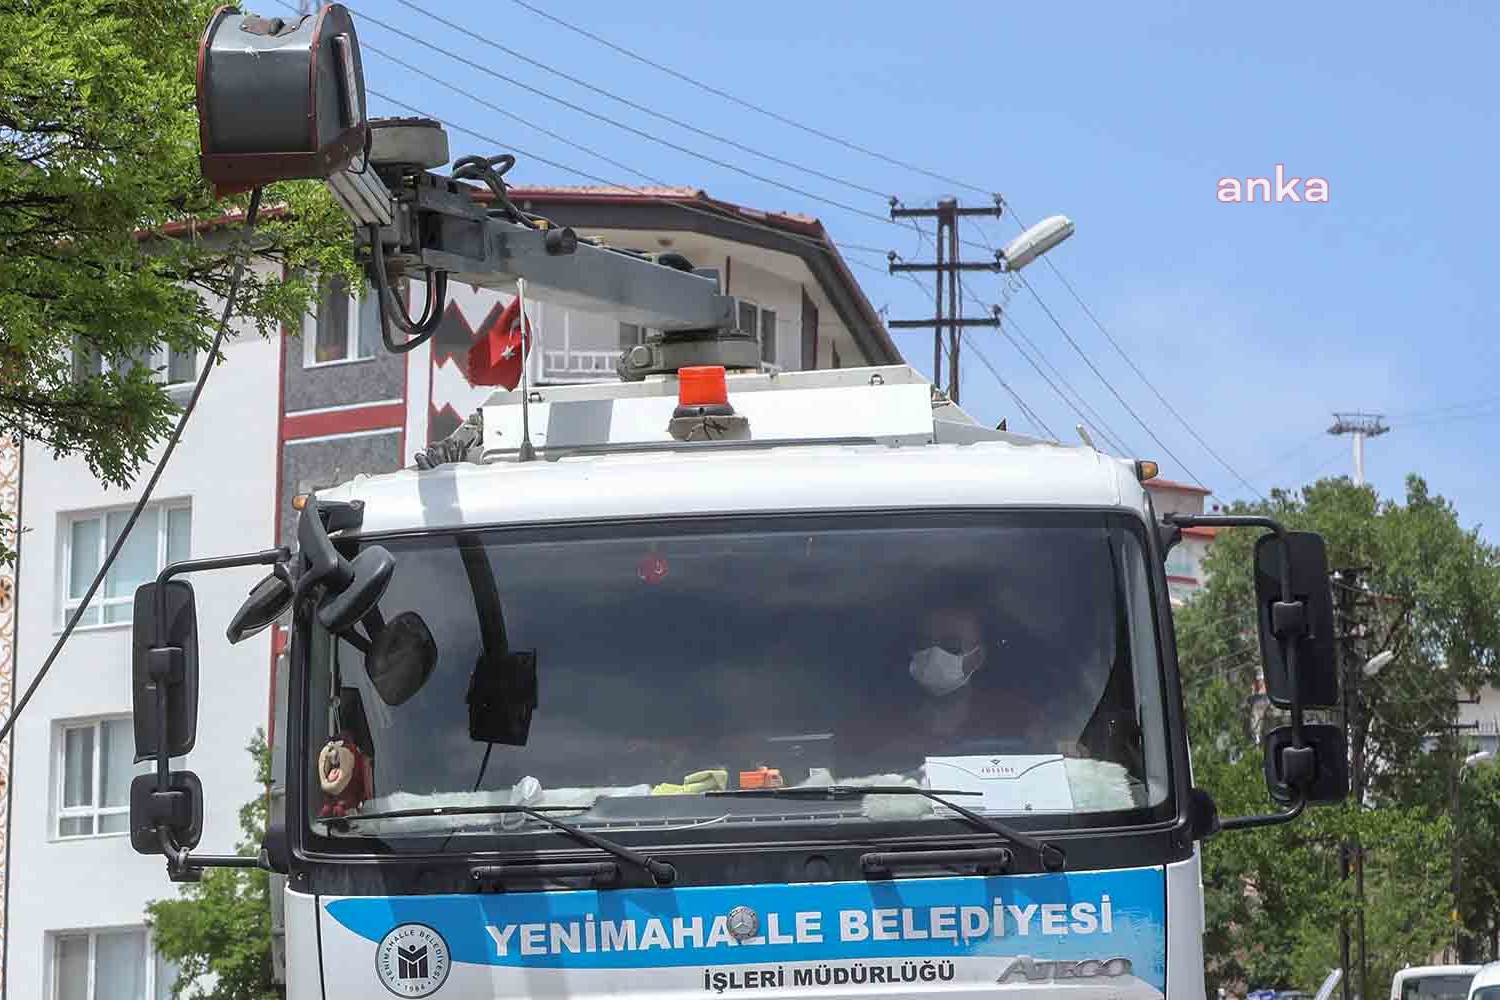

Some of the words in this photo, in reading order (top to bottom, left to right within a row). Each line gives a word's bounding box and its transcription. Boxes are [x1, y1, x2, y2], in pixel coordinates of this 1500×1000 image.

[839, 894, 1113, 943] BELEDİYESİ
[703, 965, 785, 994] İŞLERİ
[793, 959, 956, 986] MÜDÜRLÜĞÜ
